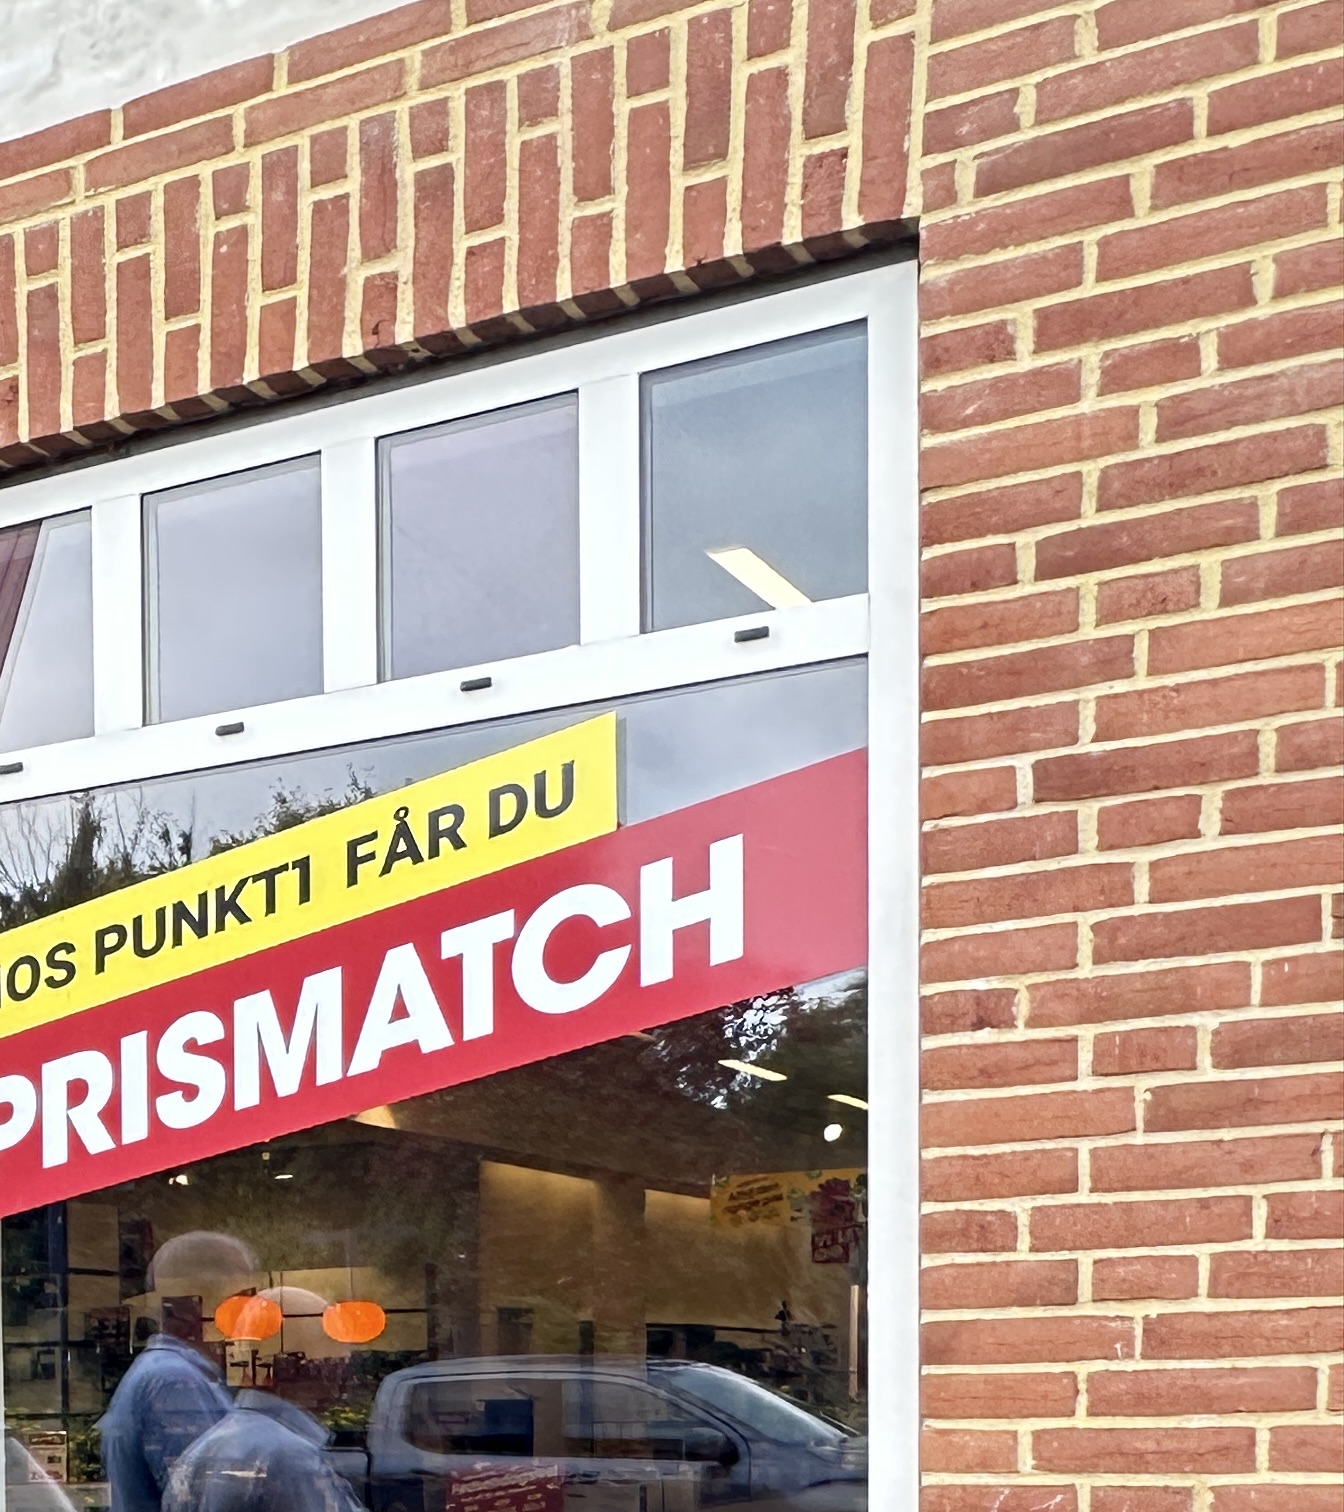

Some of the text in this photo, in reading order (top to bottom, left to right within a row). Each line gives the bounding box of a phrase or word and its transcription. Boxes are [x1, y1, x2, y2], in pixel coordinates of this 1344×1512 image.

[96, 855, 310, 975] PUNKT1
[346, 807, 467, 889] FÅR
[488, 760, 576, 839] DU
